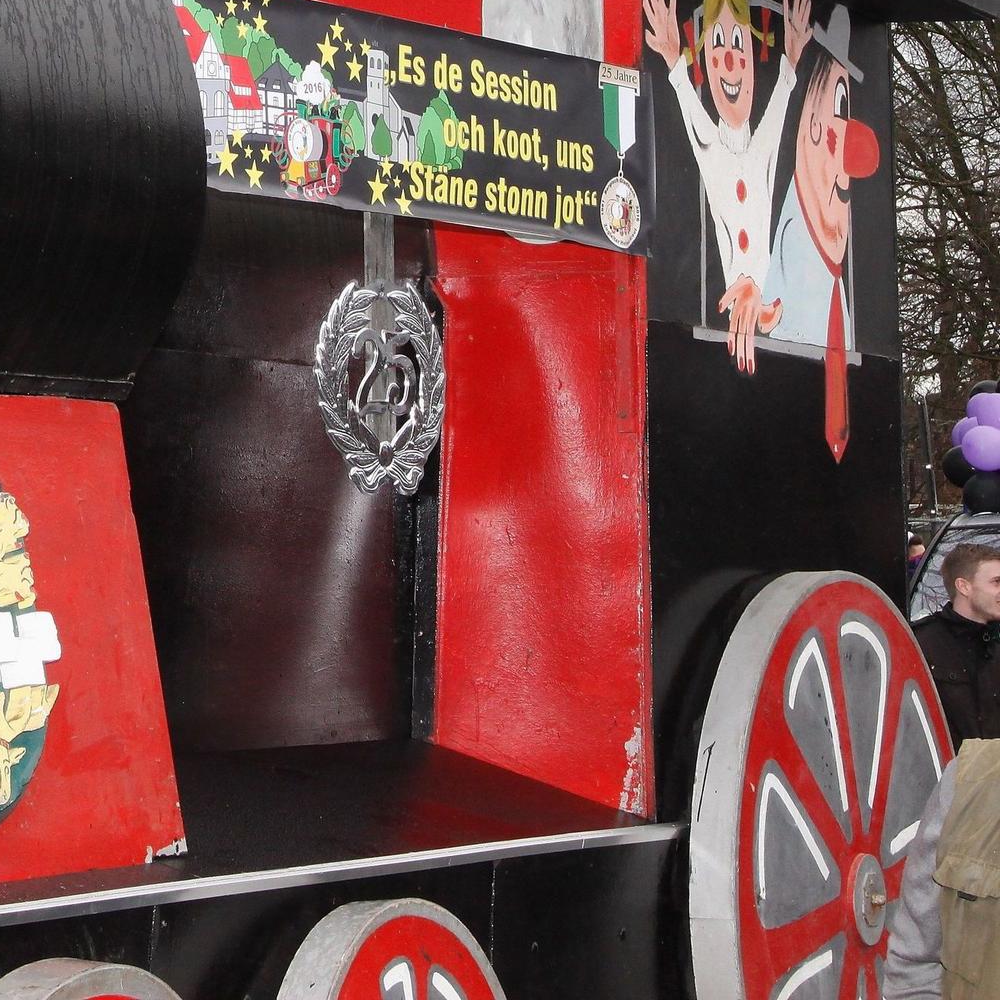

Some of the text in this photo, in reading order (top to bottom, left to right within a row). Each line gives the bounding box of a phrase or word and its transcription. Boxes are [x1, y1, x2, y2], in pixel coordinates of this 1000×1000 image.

[304, 83, 322, 94] 2016
[433, 53, 462, 93] de
[470, 59, 557, 112] Session
[602, 66, 637, 84] 25 Jahre
[443, 115, 594, 172] och koot, uns
[409, 161, 478, 209] Stäne
[485, 177, 547, 219] stonn
